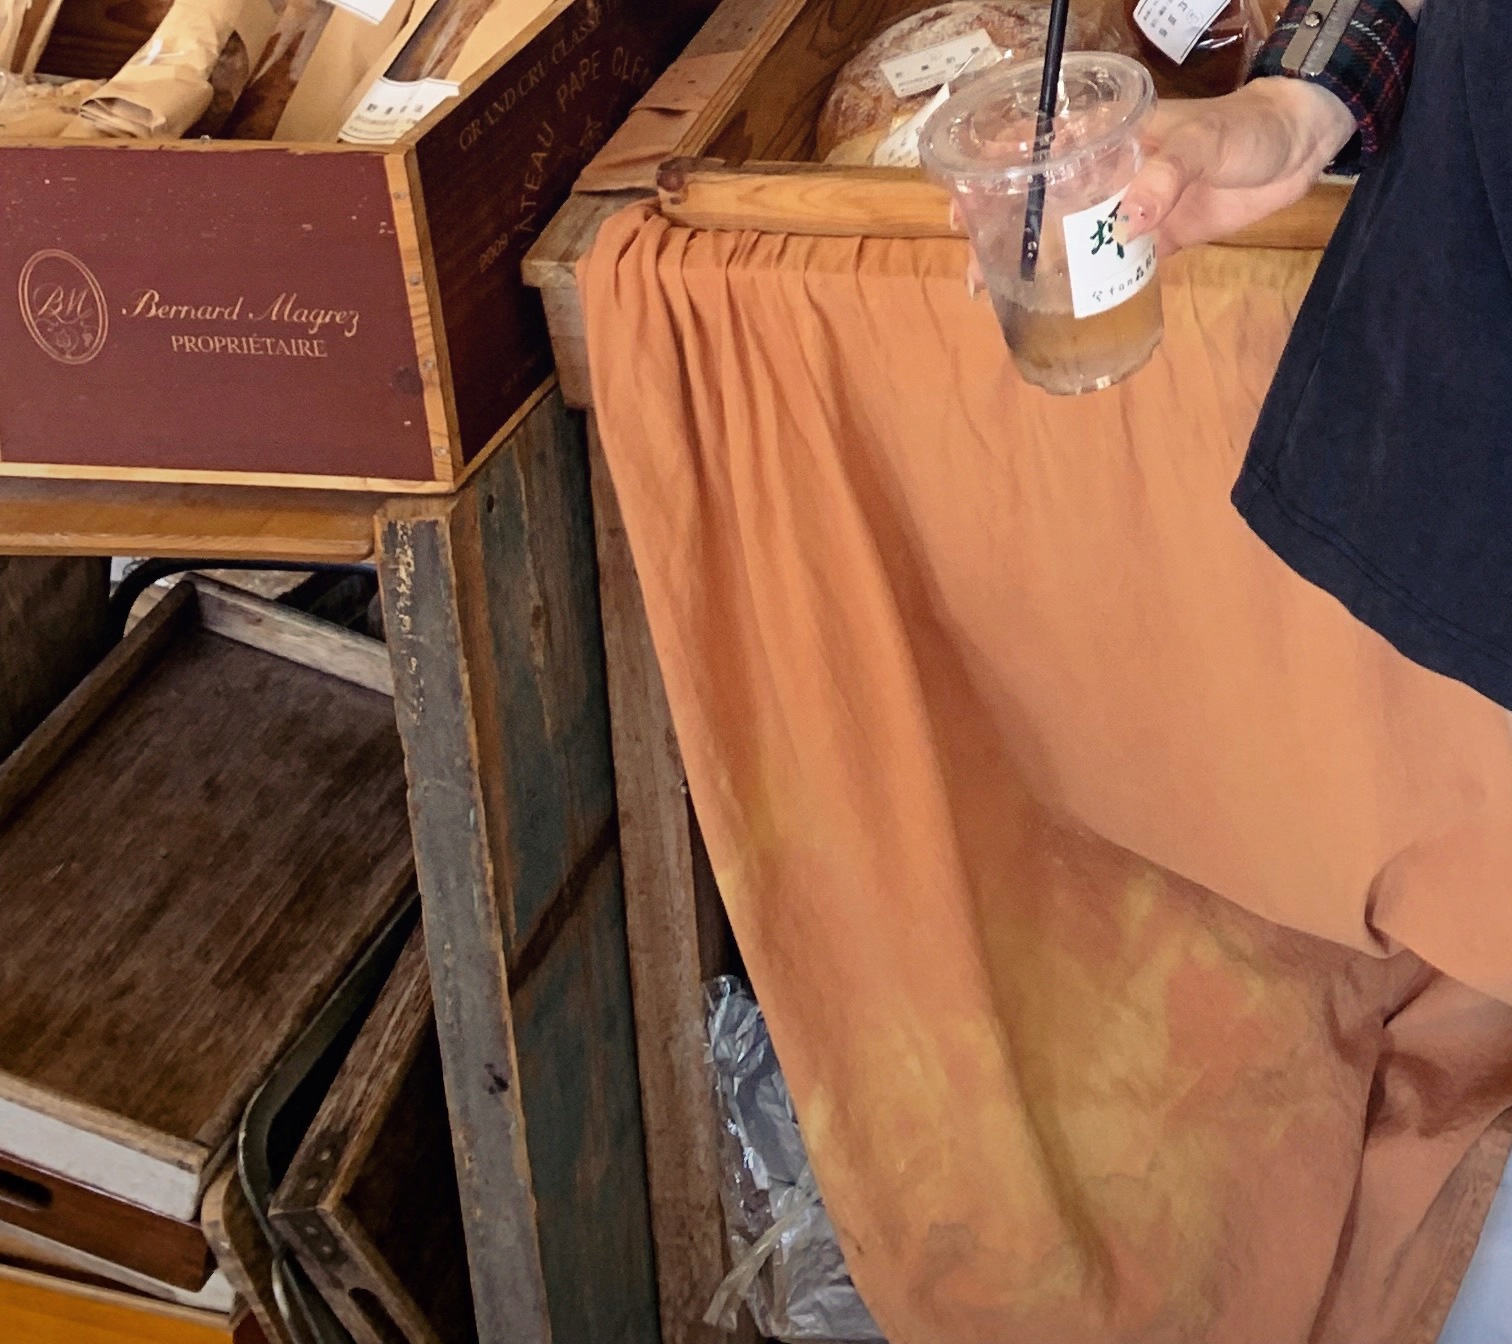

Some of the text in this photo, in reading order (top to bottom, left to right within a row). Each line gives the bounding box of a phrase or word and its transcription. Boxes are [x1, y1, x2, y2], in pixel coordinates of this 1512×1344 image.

[121, 288, 360, 338] Bernard Magrez
[170, 332, 329, 358] PROPRIÉTAIRE
